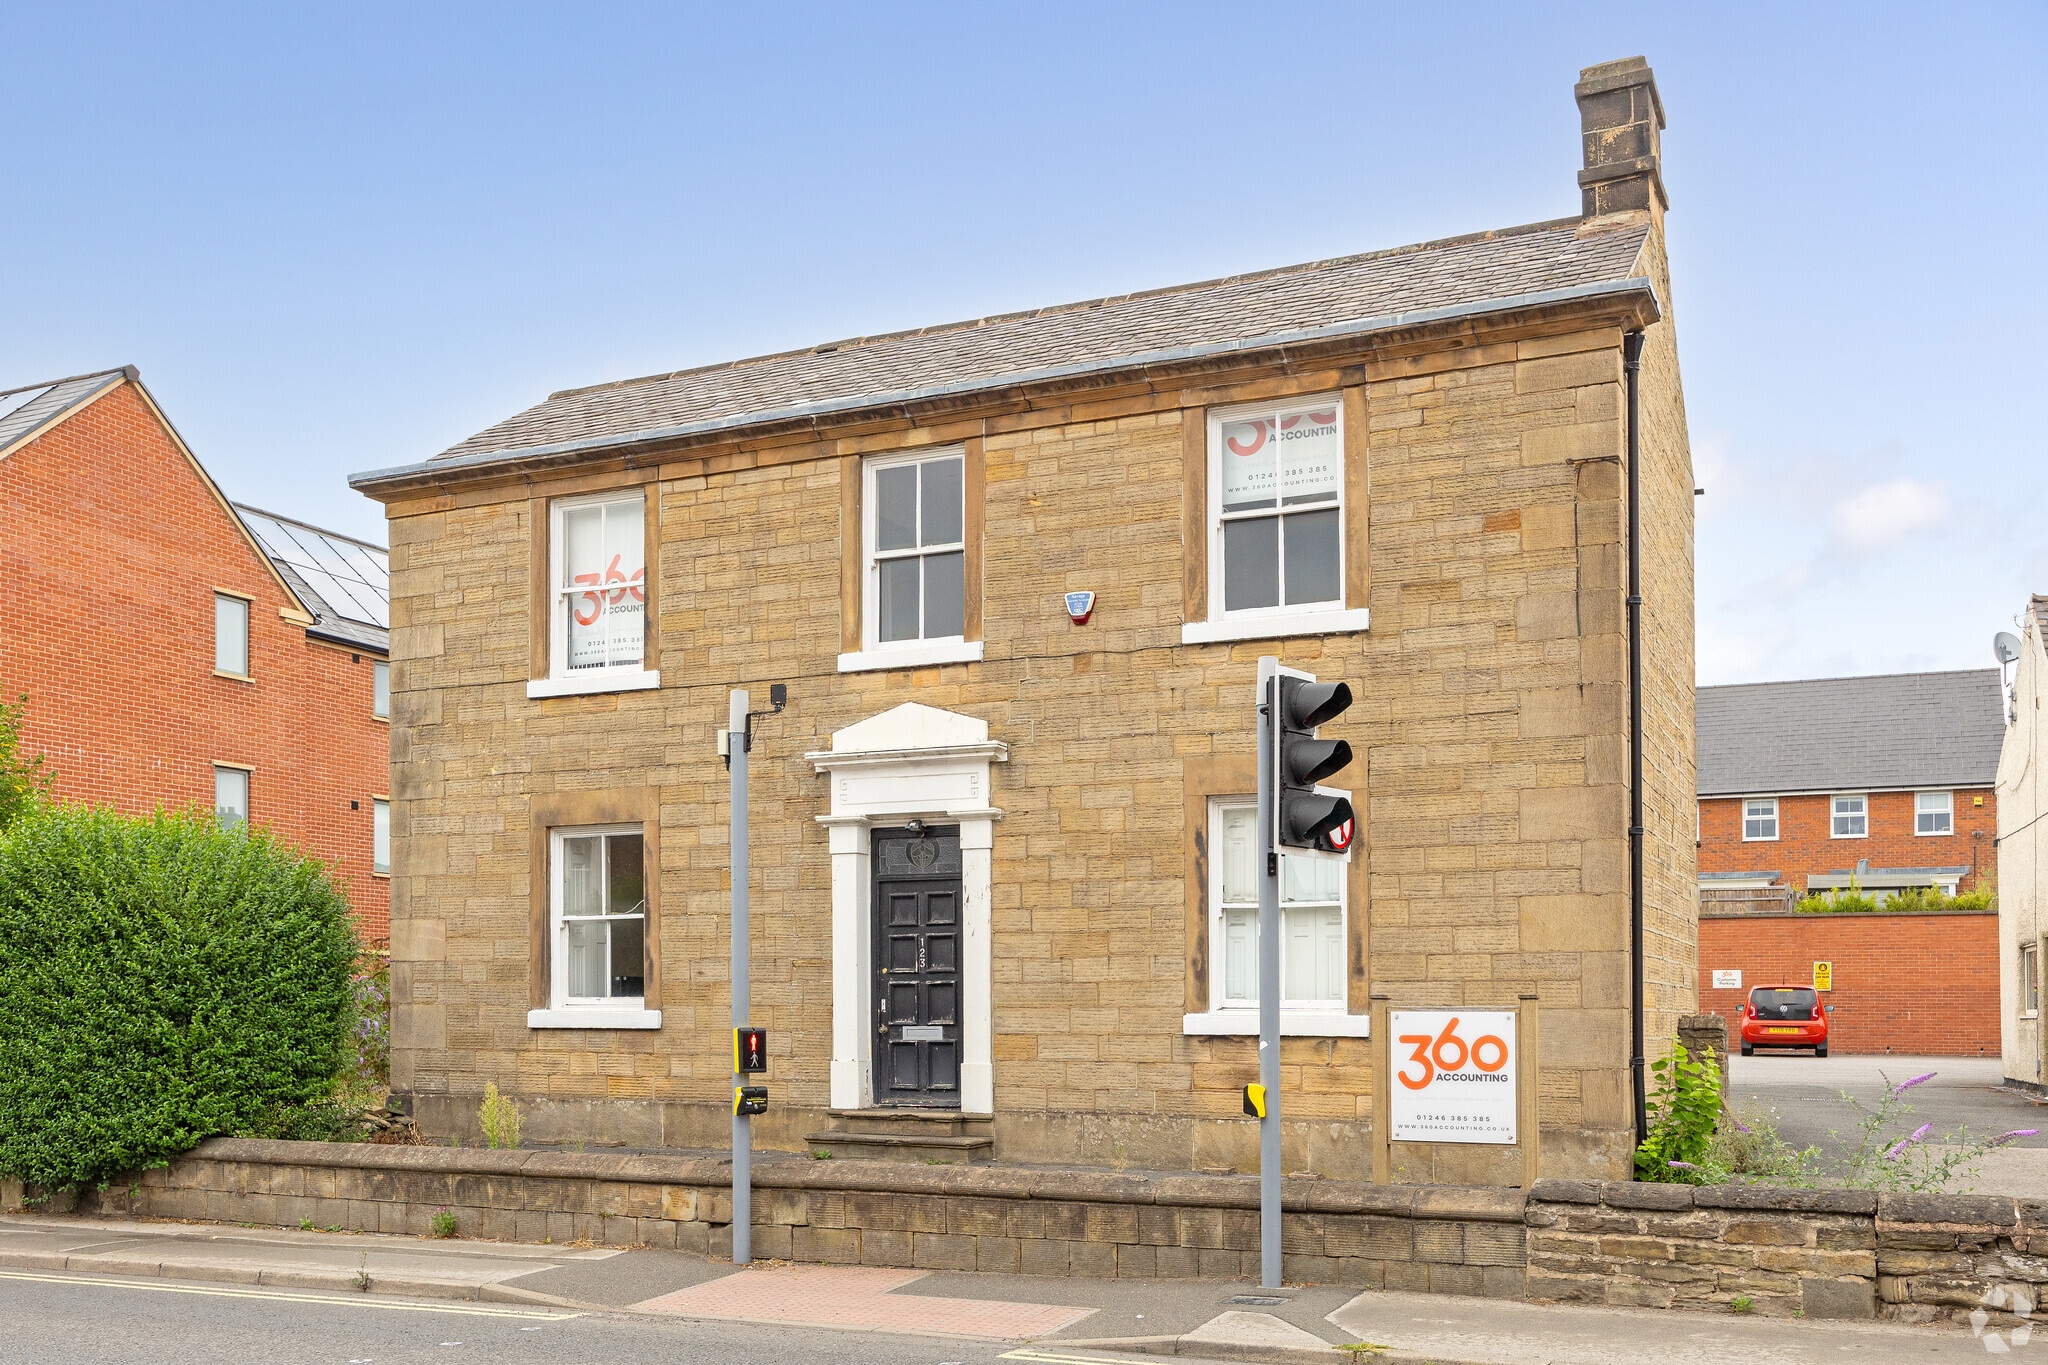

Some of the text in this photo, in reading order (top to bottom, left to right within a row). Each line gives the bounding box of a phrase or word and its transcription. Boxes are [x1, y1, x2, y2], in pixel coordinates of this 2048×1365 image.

[1309, 466, 1328, 474] 385
[1228, 476, 1337, 493] WWW.360ACOUNTING.CO.
[1398, 1017, 1508, 1090] 360
[1435, 1073, 1508, 1083] ACCOUNTING
[1398, 1124, 1511, 1132] WWW.360ACCOUNTING.CO.UK
